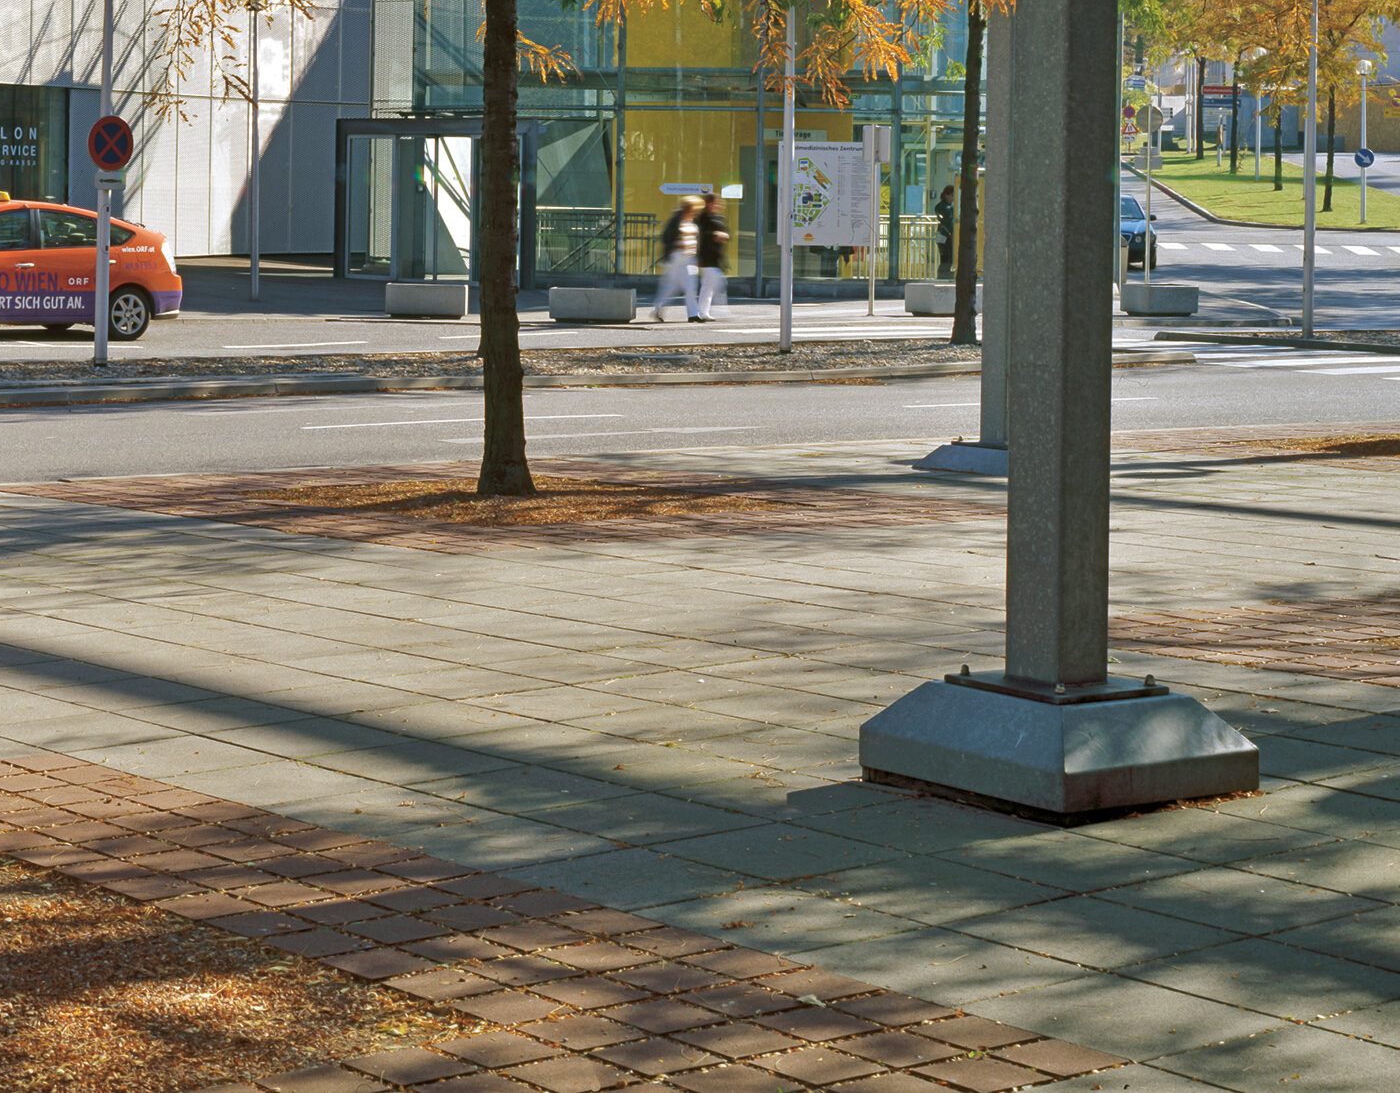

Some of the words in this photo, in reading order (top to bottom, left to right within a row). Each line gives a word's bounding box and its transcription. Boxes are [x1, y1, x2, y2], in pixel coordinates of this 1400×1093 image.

[14, 272, 64, 292] WIEN.
[68, 277, 89, 285] ORF
[14, 296, 40, 309] SICH
[43, 296, 65, 309] GUT
[66, 296, 85, 309] AN.
